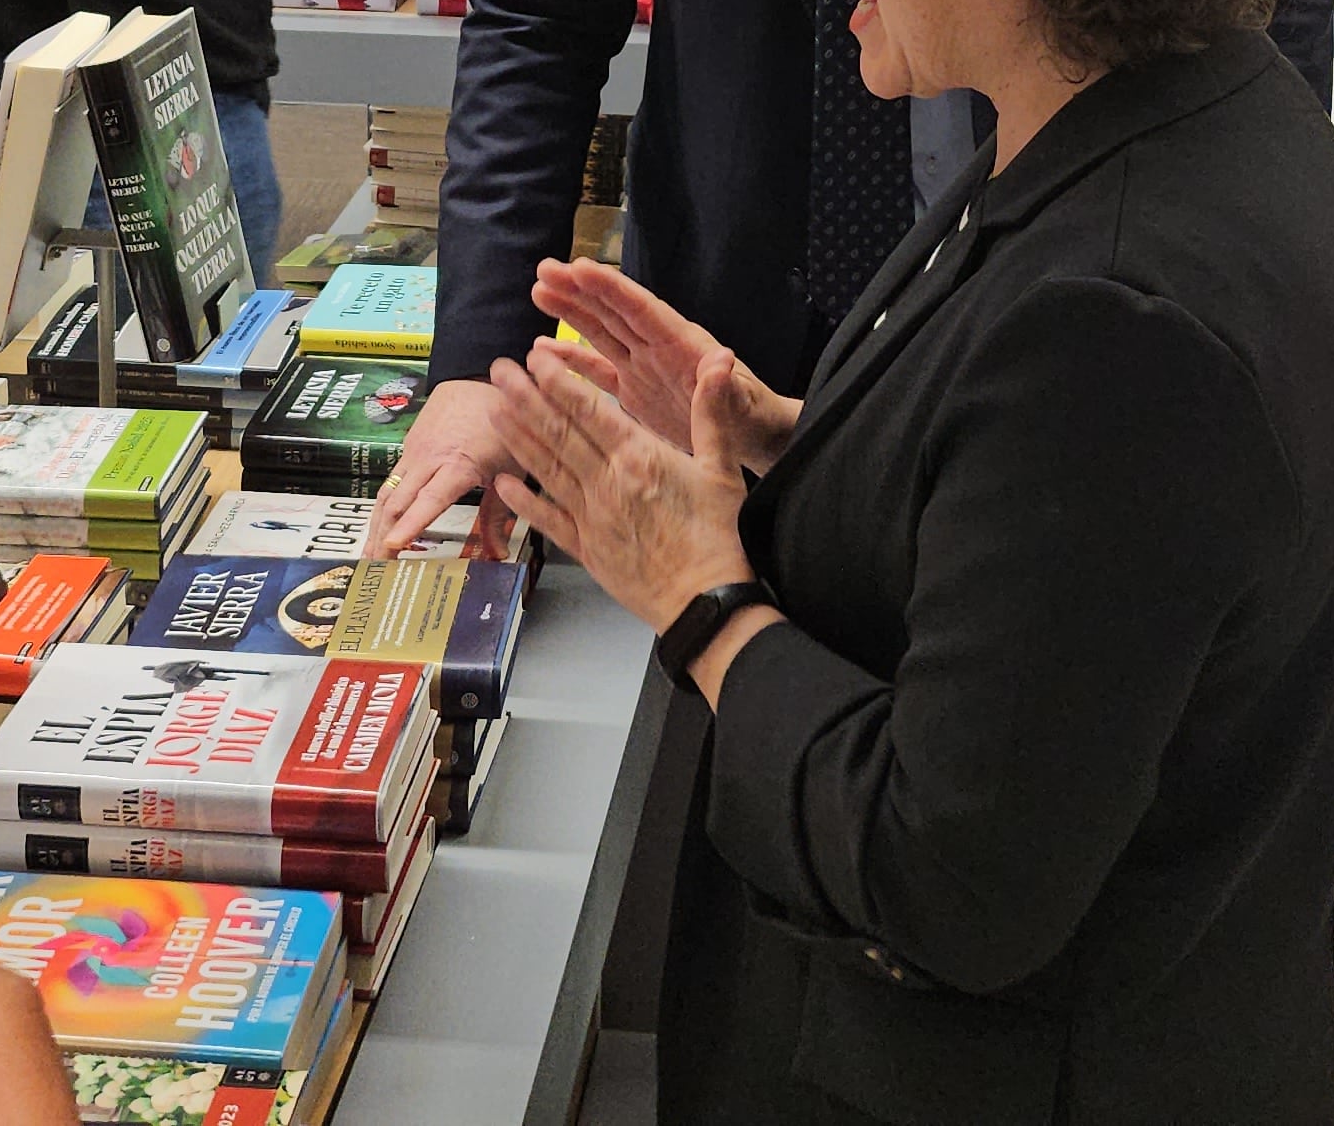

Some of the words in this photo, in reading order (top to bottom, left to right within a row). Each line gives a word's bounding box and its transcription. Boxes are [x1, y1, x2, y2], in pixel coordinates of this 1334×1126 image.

[144, 50, 196, 102] LETICIA
[154, 81, 201, 130] SIERRA
[108, 173, 146, 188] LETICIA
[111, 185, 147, 198] SIERRA
[118, 212, 130, 224] LO
[130, 209, 153, 223] QUE
[120, 220, 156, 234] OCULTA
[179, 206, 198, 236] LO
[193, 183, 221, 225] QUE
[125, 240, 161, 254] TIERRA
[132, 231, 146, 243] LA
[176, 222, 222, 273] OCULTA
[215, 205, 237, 236] LA
[192, 241, 237, 295] TIERRA
[340, 304, 366, 317] Te
[354, 272, 385, 303] receto
[373, 299, 394, 313] un
[382, 278, 406, 300] gato
[285, 369, 337, 421] LETICIA
[317, 373, 364, 420] SIERRA
[68, 450, 88, 458] El
[163, 569, 232, 642] JAVIER
[205, 569, 269, 640] SIERRA
[344, 606, 372, 634] PLAN
[338, 637, 362, 652] EL
[29, 716, 97, 744] EL
[83, 691, 175, 764] ESPÍA
[145, 686, 232, 774] JORGE
[206, 707, 279, 763] DÍAZ
[342, 714, 387, 771] CARMEN
[365, 671, 405, 713] MOLA
[102, 806, 120, 823] EL
[118, 788, 140, 825] SPÍA
[142, 787, 159, 828] ORGE
[110, 858, 128, 873] EL
[126, 839, 148, 874] SPÍA
[143, 915, 211, 1000] COLLEEN
[175, 897, 285, 1031] HOOVER
